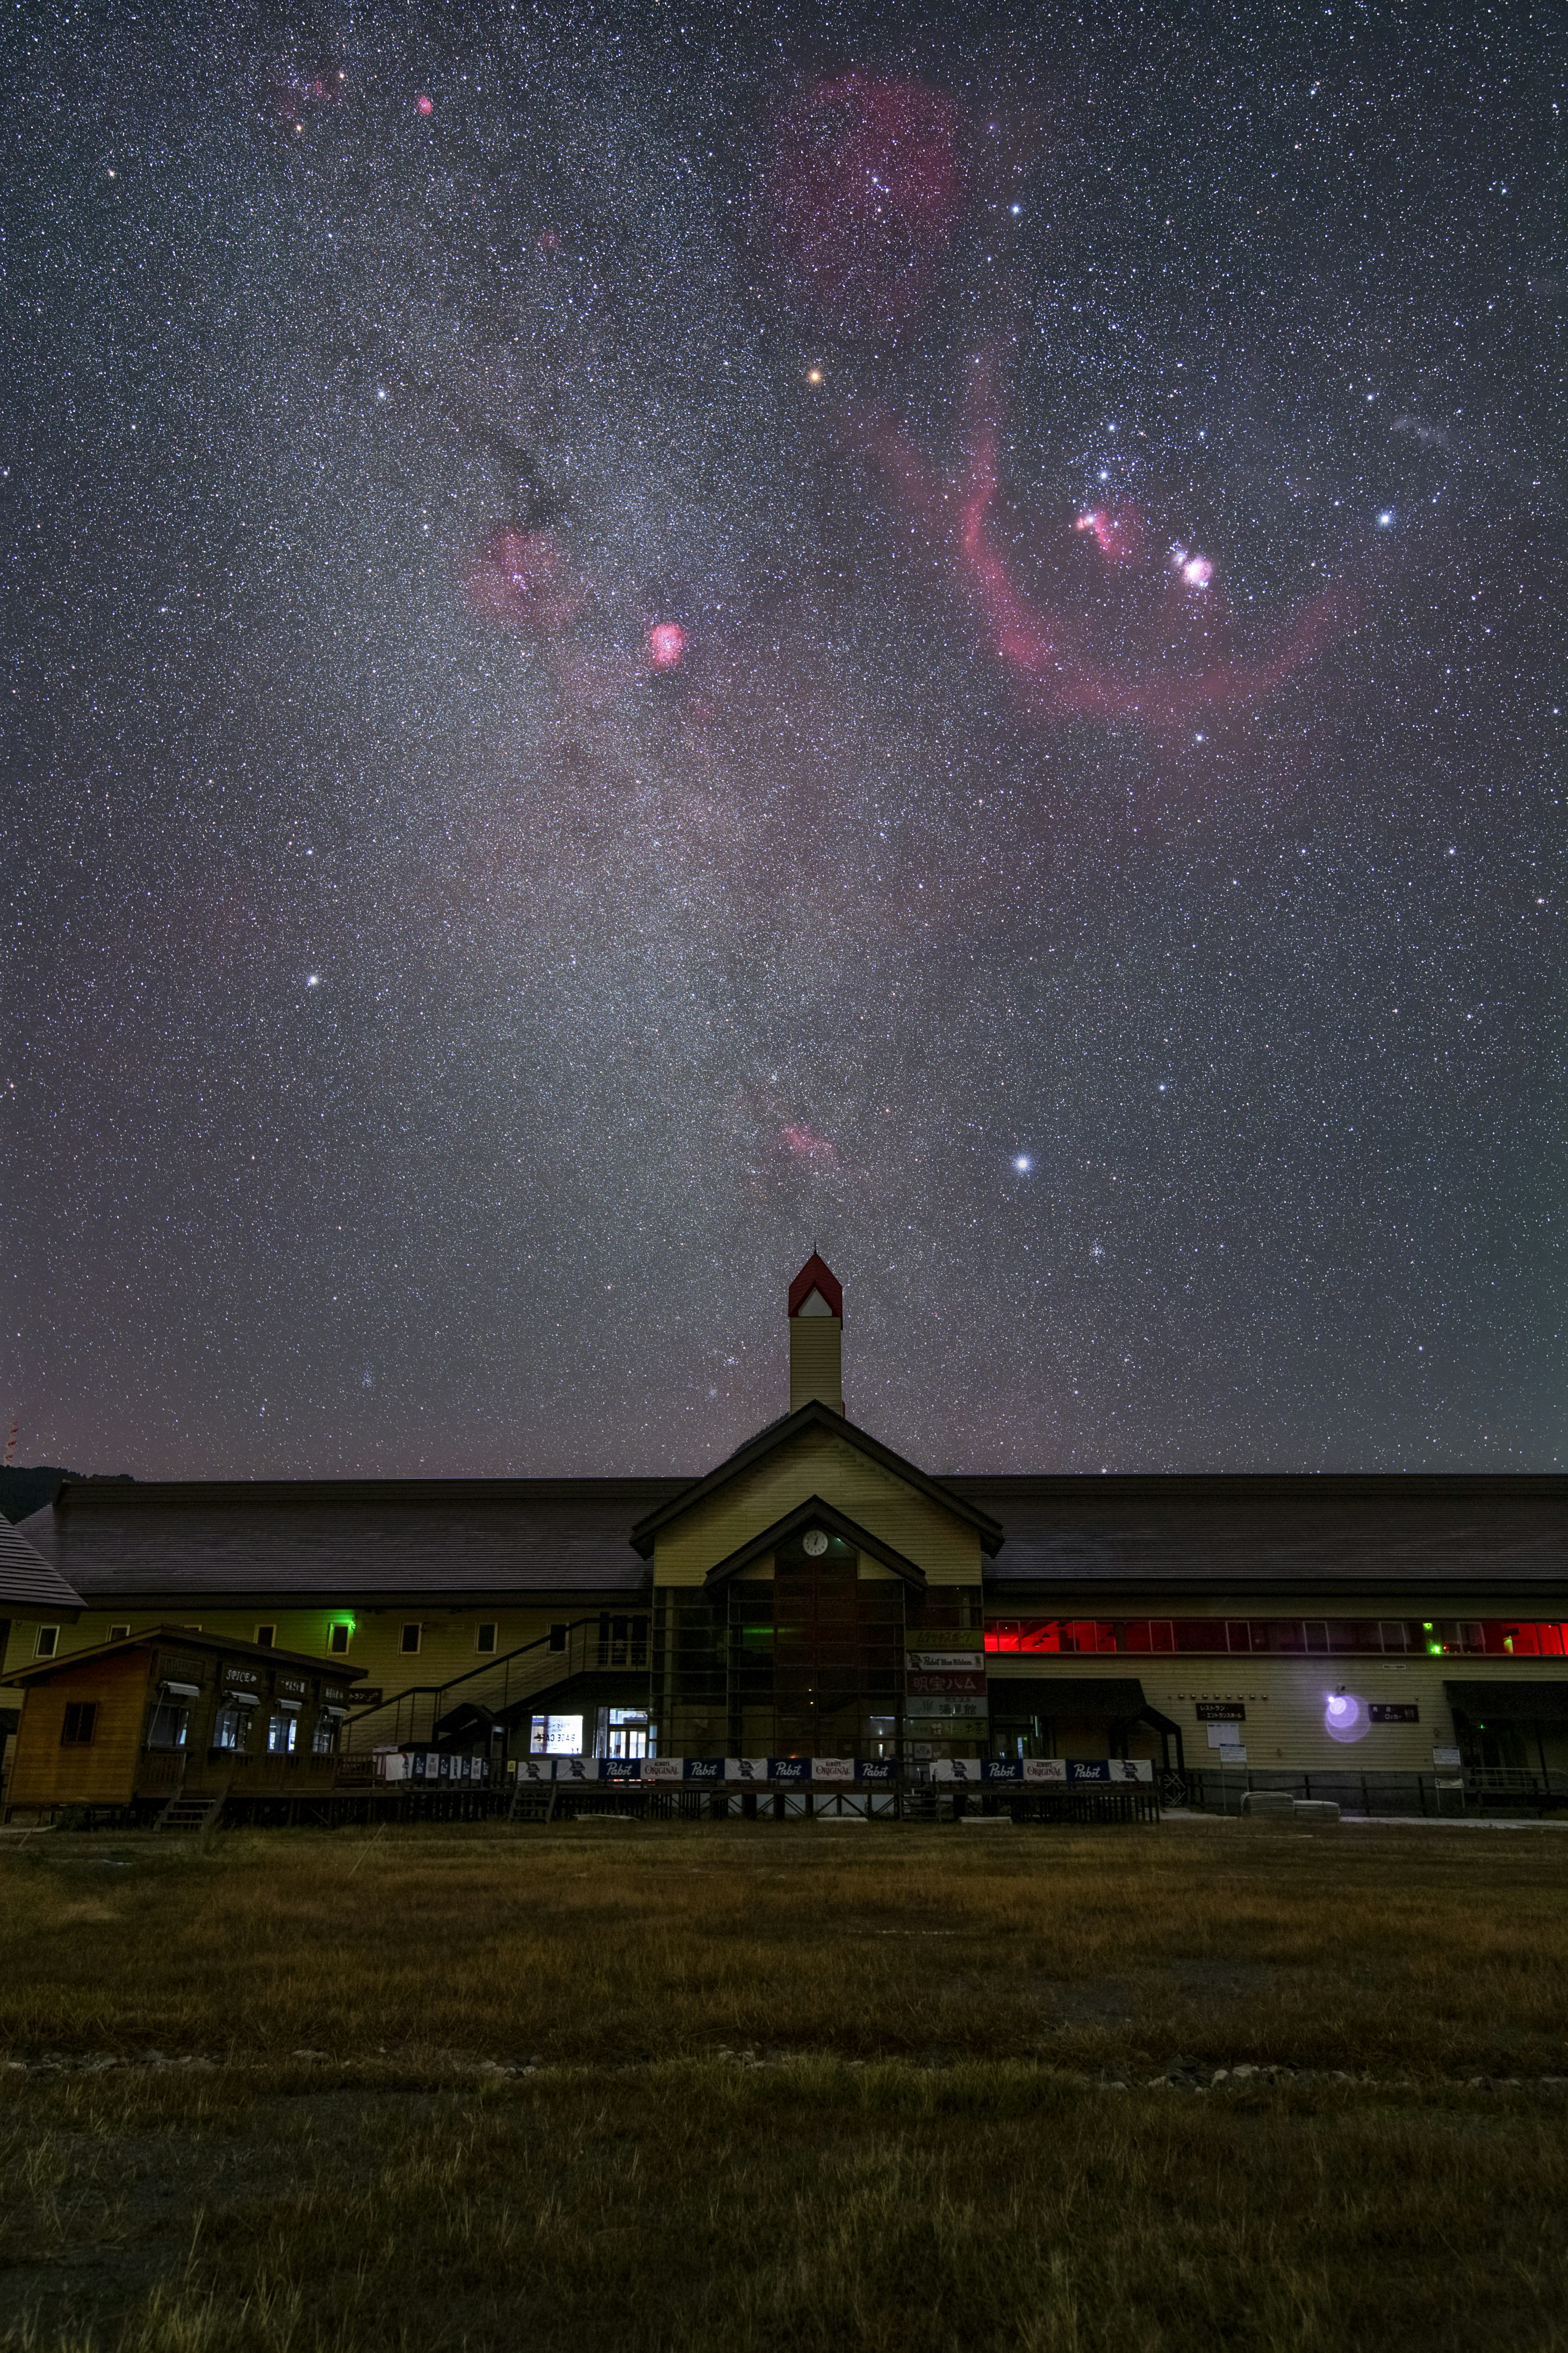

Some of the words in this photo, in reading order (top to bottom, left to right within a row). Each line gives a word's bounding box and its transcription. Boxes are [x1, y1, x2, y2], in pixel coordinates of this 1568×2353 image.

[917, 1632, 972, 1642] ムラサキスポーツ
[923, 1656, 940, 1665] Pabst
[226, 1670, 250, 1682] SPICE
[913, 1675, 977, 1691] 明宝ハム
[606, 1762, 633, 1775] Pabst
[645, 1765, 679, 1776] ORIGINAL
[691, 1762, 718, 1775] Pabst
[775, 1762, 802, 1775] Pabst
[816, 1765, 850, 1776] ORIGINAL
[862, 1763, 889, 1777] Pabst
[989, 1762, 1016, 1777] Pabst
[1027, 1766, 1062, 1777] ORIGINAL
[1074, 1763, 1101, 1778] Pabst
